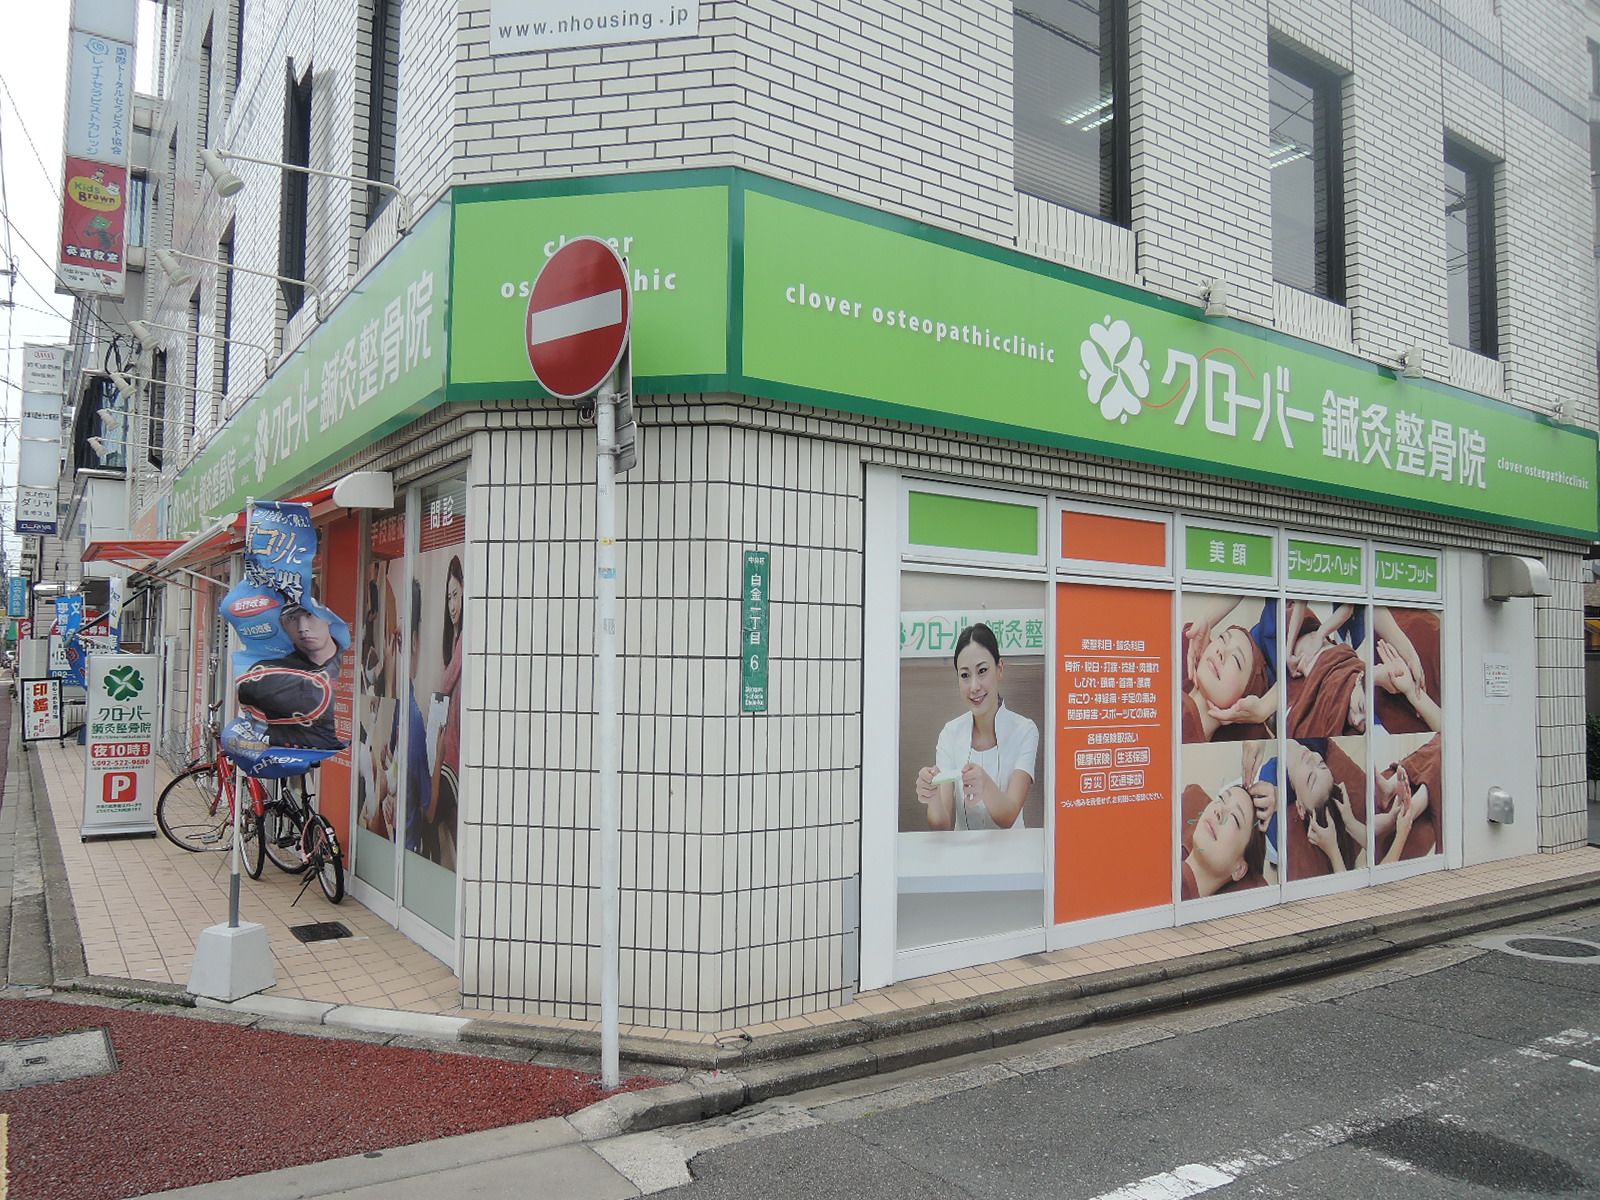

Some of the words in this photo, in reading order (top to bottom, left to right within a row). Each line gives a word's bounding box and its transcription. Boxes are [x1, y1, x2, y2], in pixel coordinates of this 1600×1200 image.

[499, 12, 689, 39] www.nhousing.jp
[74, 181, 100, 193] Kids
[78, 191, 116, 204] Brown
[65, 244, 120, 263] 英語教室
[785, 283, 863, 319] clover
[871, 304, 1056, 364] osteopathicclinic
[1497, 456, 1523, 475] clover
[430, 495, 454, 530] 問診
[1375, 559, 1435, 584] ハンド・フット
[750, 573, 762, 646] 白金一丁目
[750, 654, 759, 671] 6
[99, 705, 151, 721] クローバー
[1077, 752, 1111, 766] 健康保険
[1117, 750, 1148, 764] 生活保護
[111, 775, 131, 800] P
[1110, 773, 1143, 787] 交通事故
